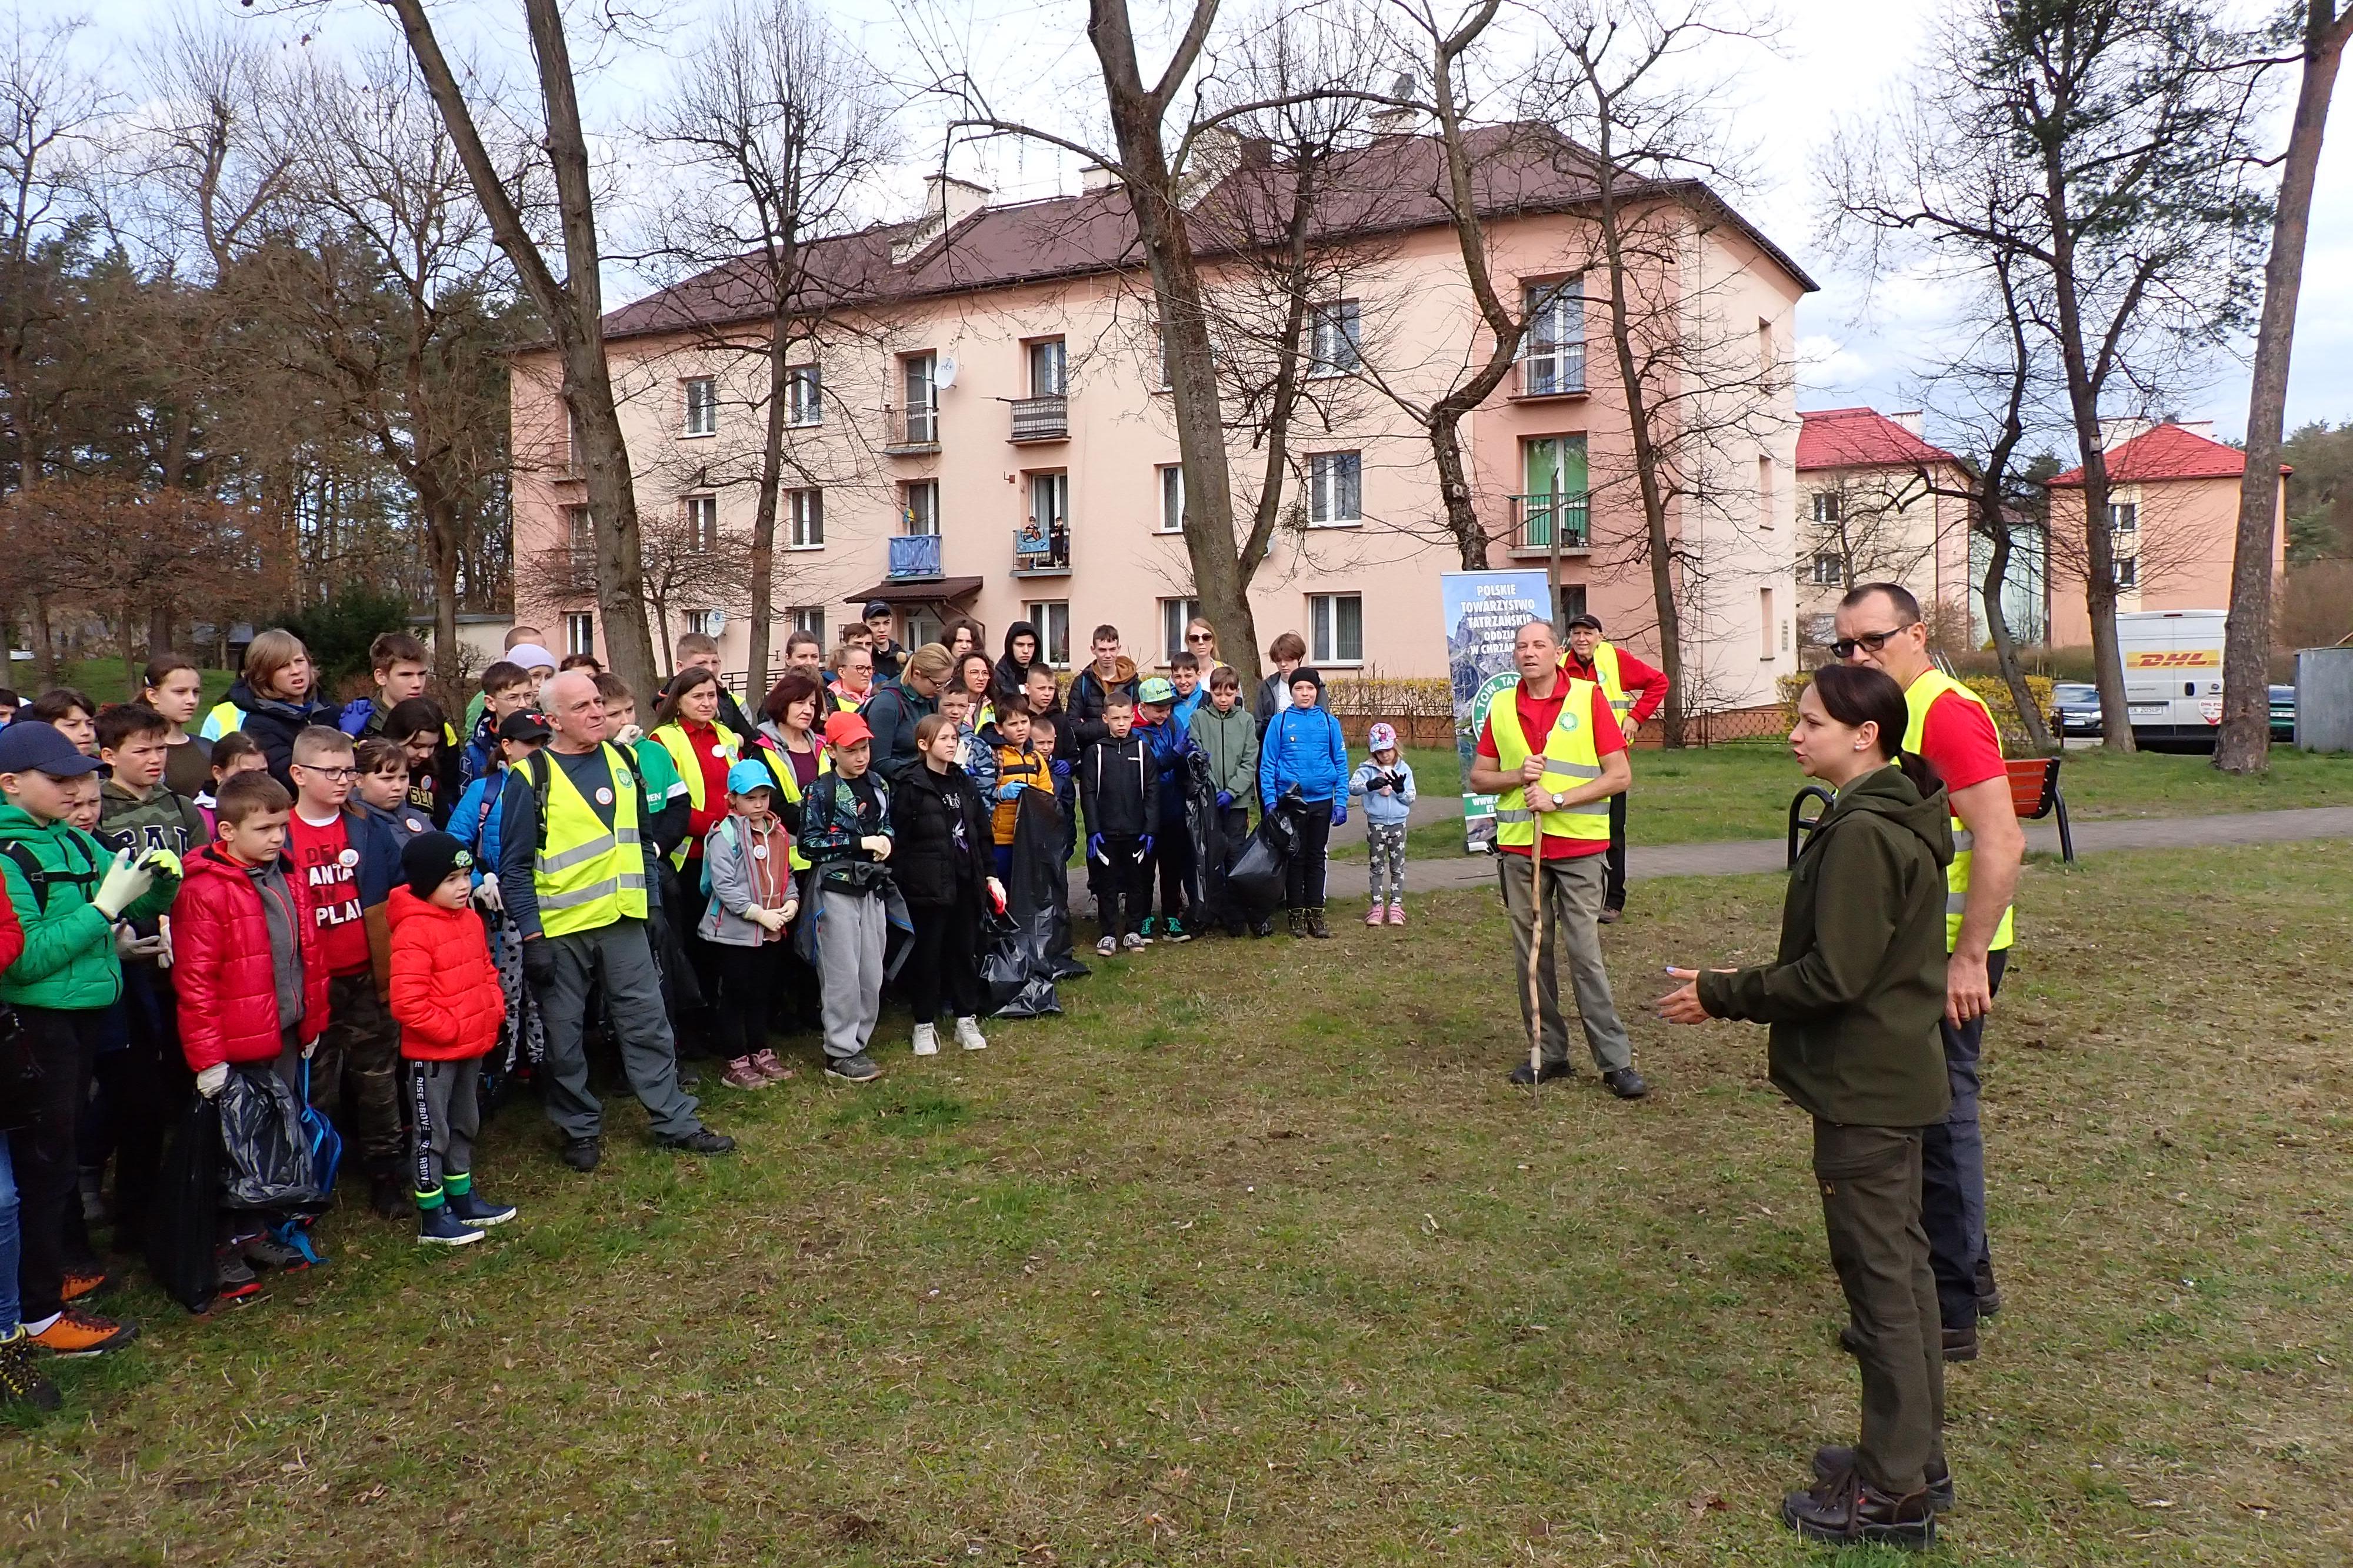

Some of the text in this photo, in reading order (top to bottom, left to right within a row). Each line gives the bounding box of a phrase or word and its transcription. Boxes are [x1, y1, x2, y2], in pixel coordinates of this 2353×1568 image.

[1477, 584, 1516, 596] POLSKIE
[1461, 599, 1535, 613] TOWARZYSTWO
[1484, 630, 1515, 641] ODDZIA
[1470, 642, 1515, 655] W CHRZAN
[2139, 653, 2207, 666] DHL
[1476, 676, 1522, 733] OL. TOW. TAT
[309, 863, 354, 886] ANTA
[314, 898, 363, 927] PLAI
